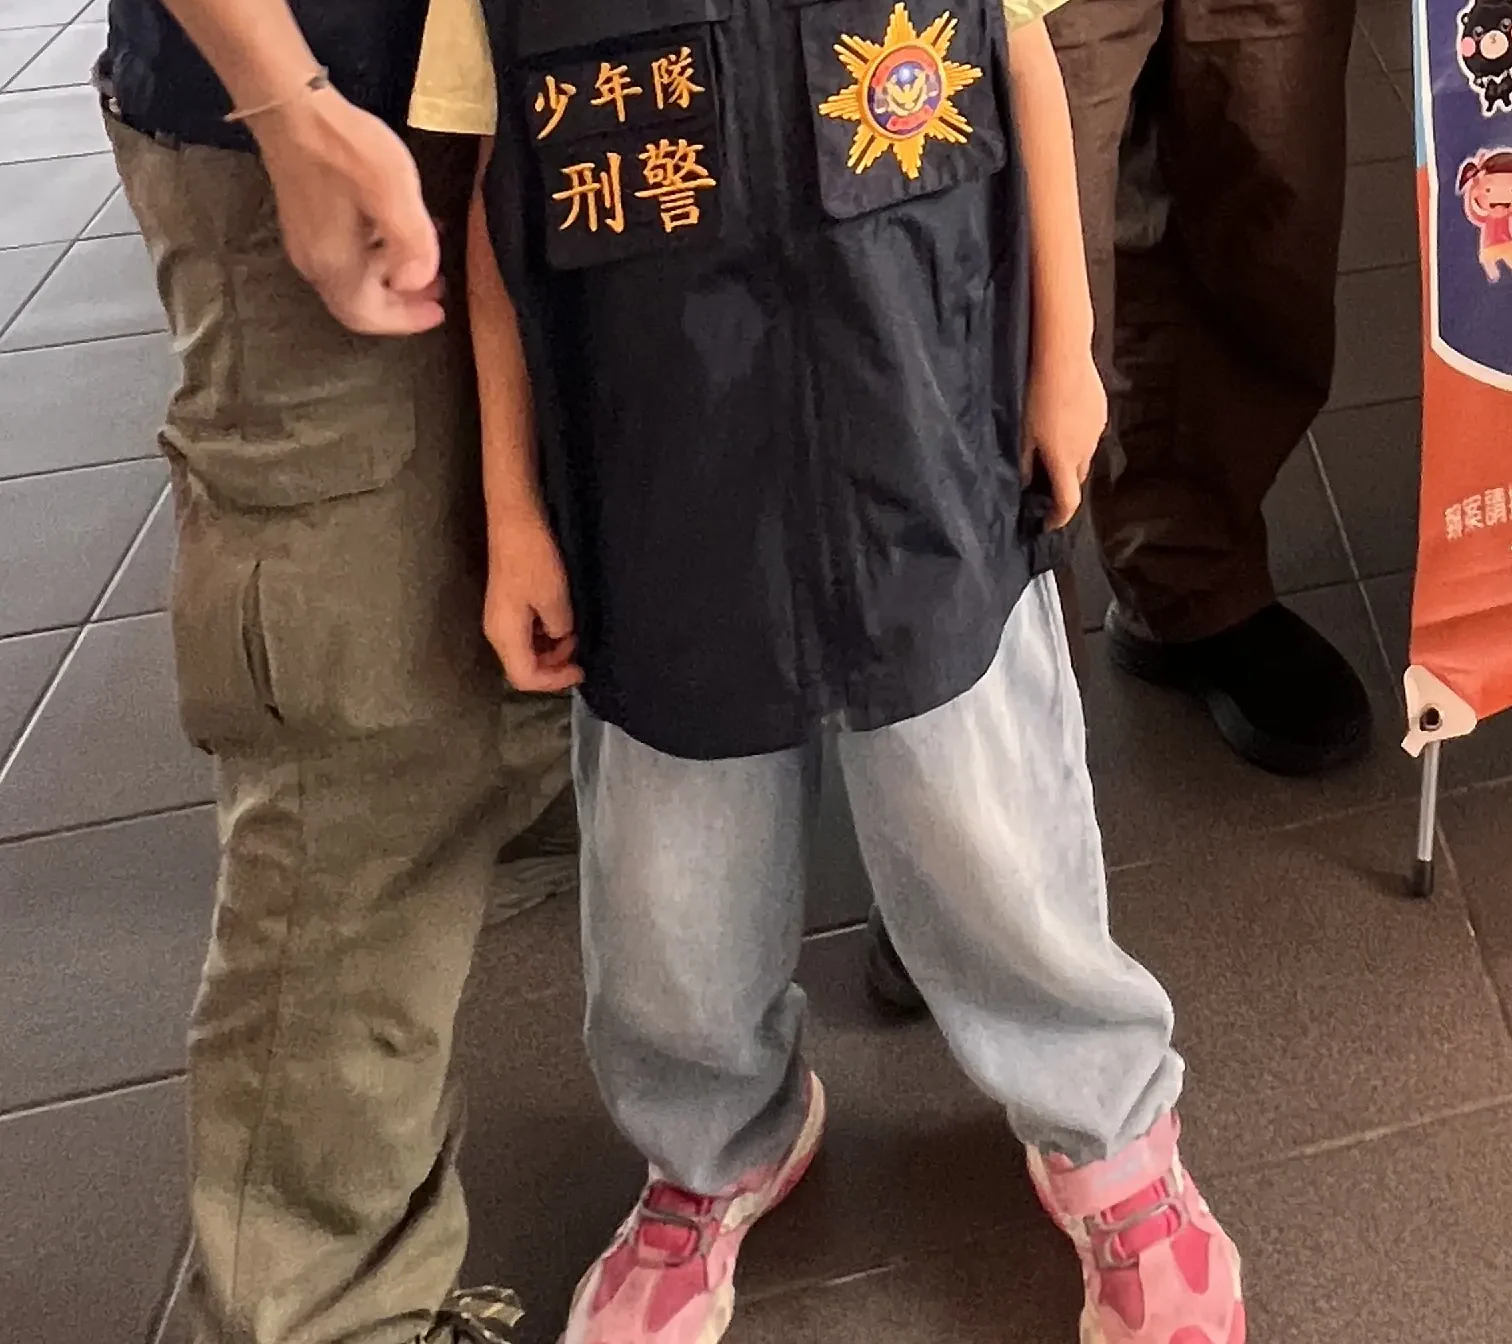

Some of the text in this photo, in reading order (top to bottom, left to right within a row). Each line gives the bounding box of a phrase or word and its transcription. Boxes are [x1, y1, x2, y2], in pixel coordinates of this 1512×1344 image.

[533, 46, 705, 140] 少年隊
[552, 139, 717, 233] 刑警
